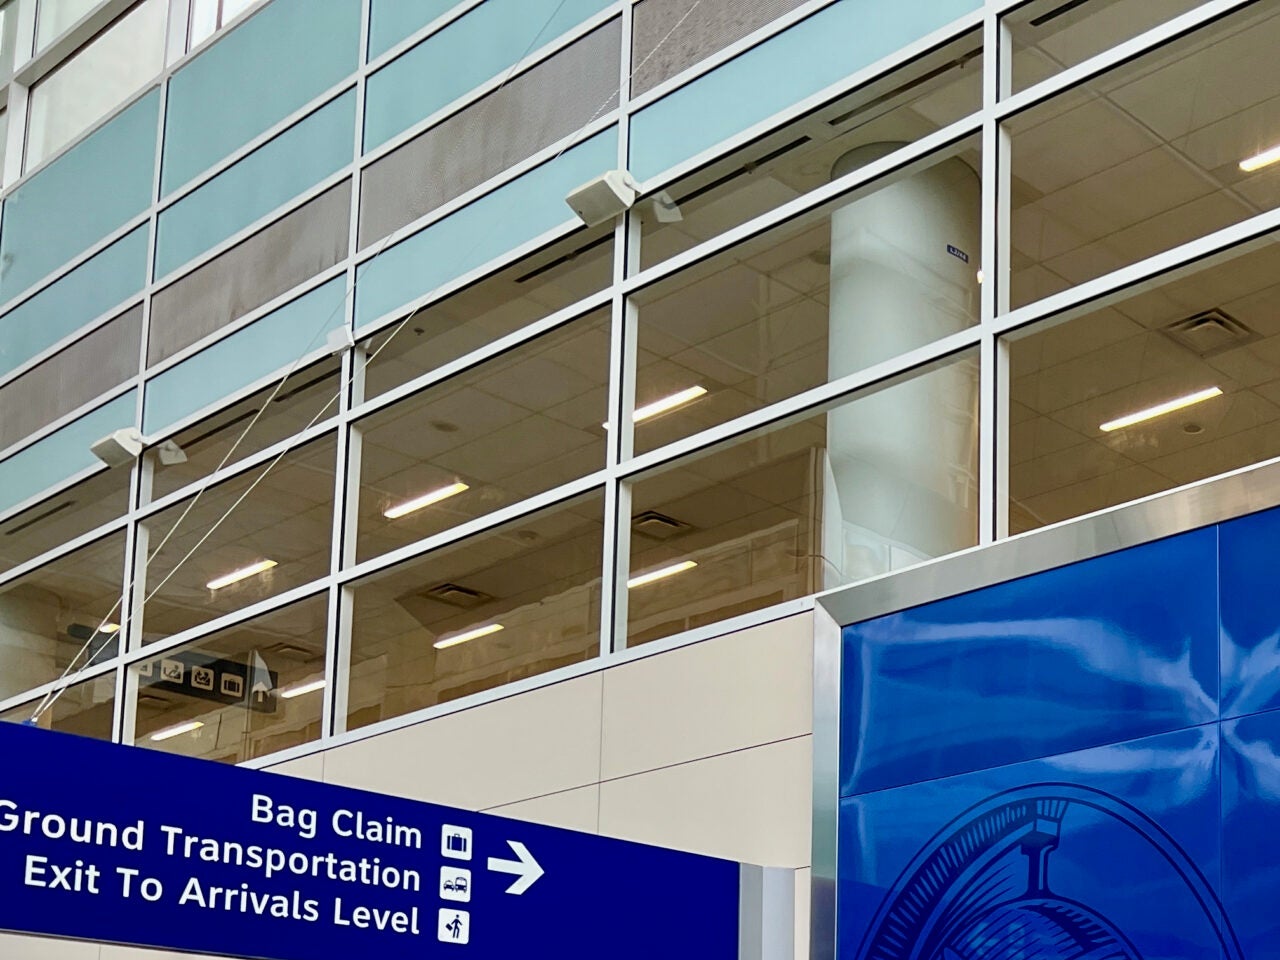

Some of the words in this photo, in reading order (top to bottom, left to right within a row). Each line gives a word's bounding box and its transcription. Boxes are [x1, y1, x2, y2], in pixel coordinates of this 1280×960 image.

[0, 799, 145, 851] Ground
[160, 824, 420, 892] Transportation
[252, 793, 317, 839] Bag
[332, 809, 422, 849] Claim
[24, 854, 100, 895] Exit
[116, 866, 163, 902] To
[178, 876, 319, 922] Arrivals
[334, 897, 420, 935] Level
